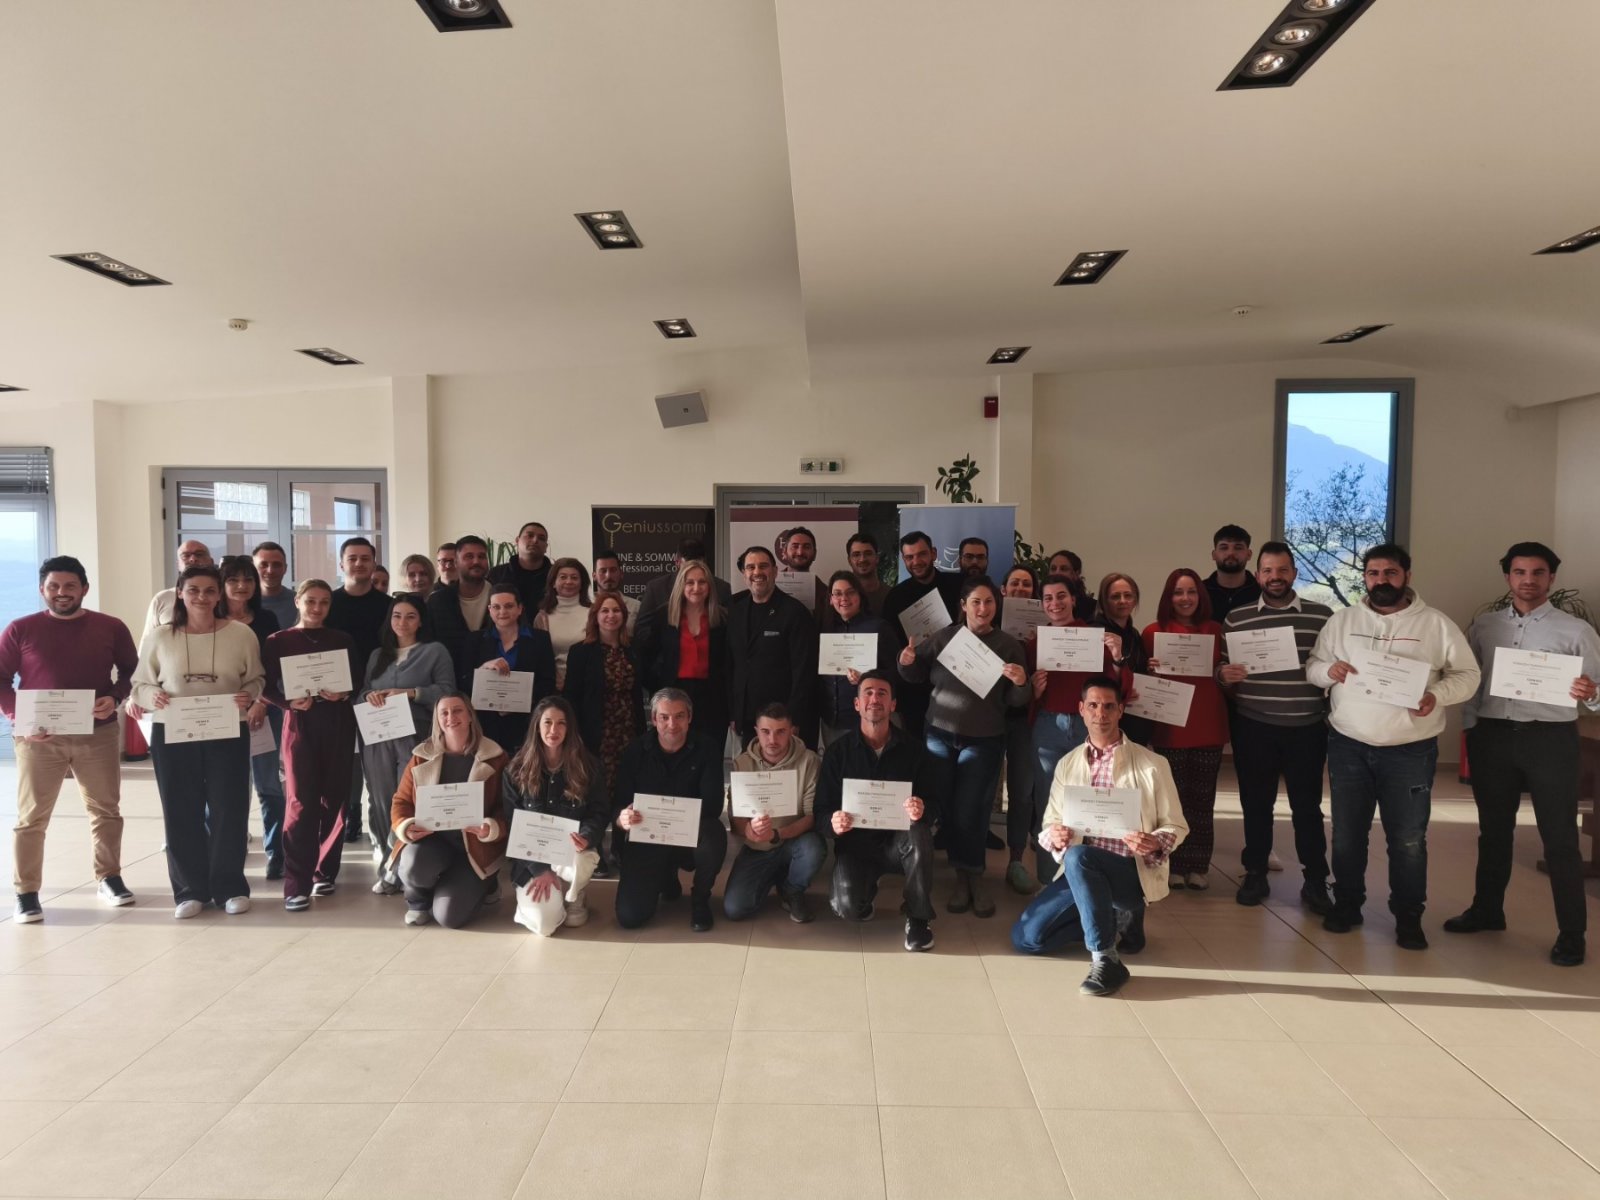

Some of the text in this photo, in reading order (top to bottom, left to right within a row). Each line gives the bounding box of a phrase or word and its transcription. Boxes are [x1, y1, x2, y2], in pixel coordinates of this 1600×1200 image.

[602, 513, 706, 536] Geniussomm
[616, 552, 678, 562] INE & SOMM
